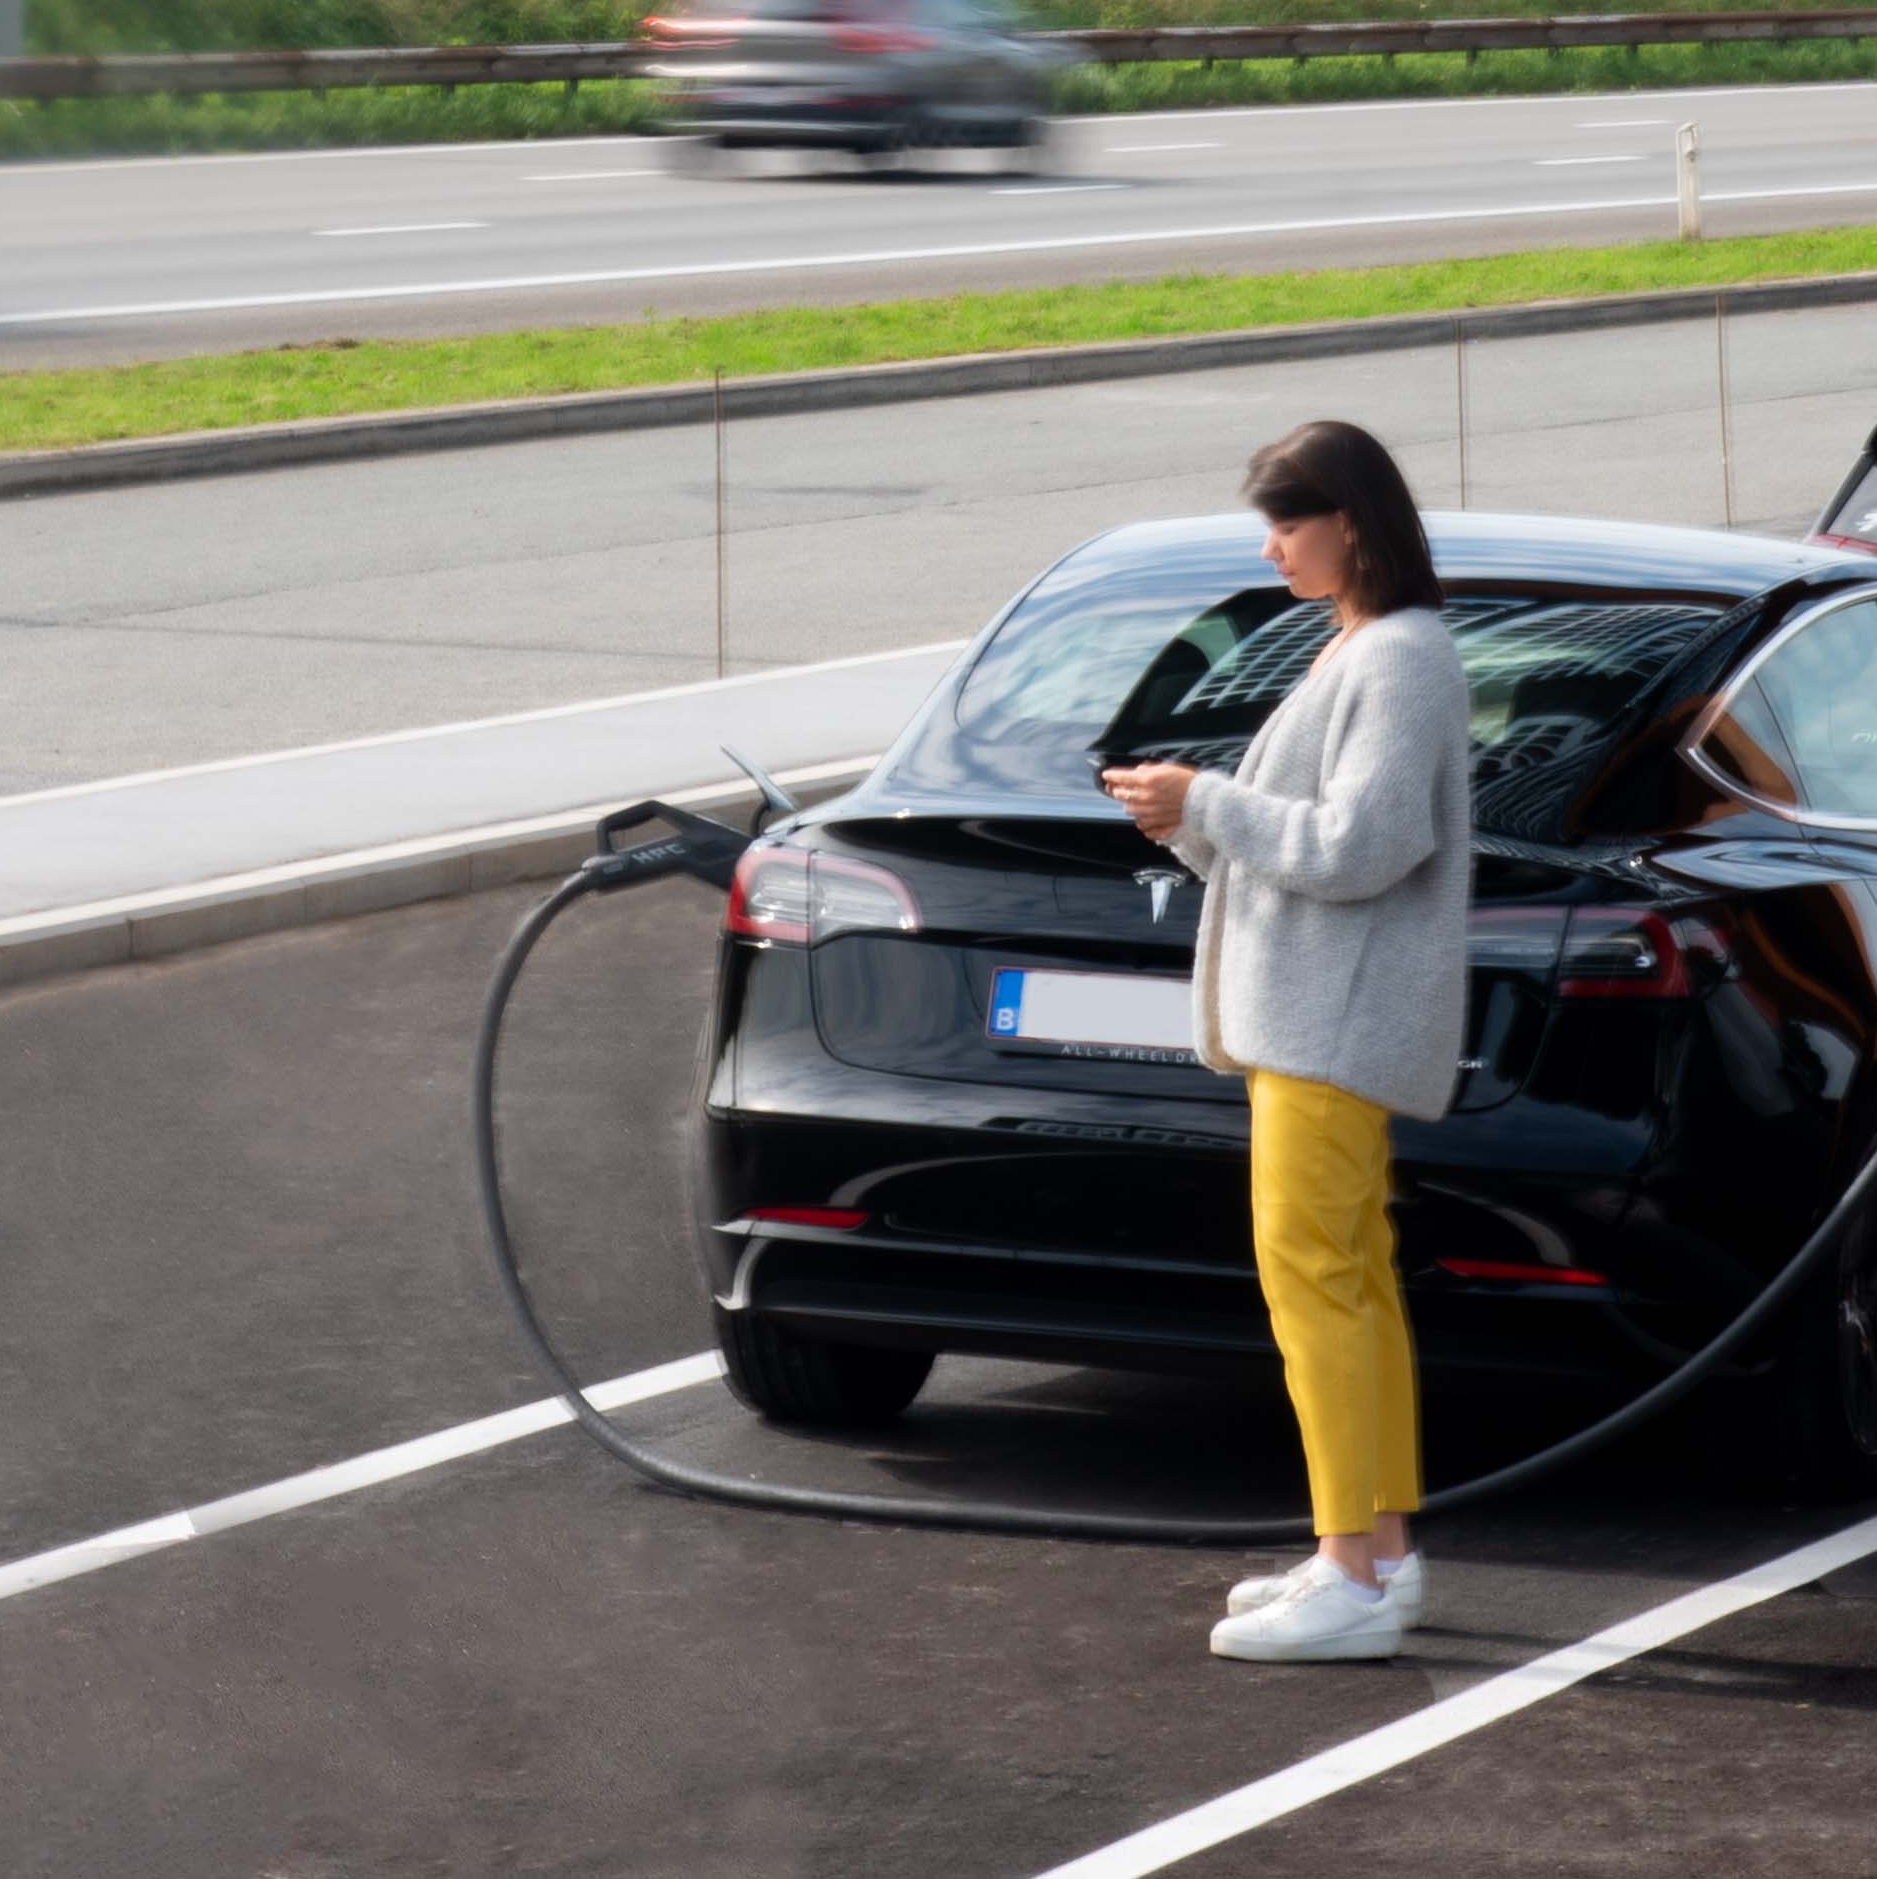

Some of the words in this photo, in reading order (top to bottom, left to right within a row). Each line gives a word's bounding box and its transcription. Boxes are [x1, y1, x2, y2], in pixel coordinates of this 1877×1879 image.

[631, 842, 686, 865] HPC
[996, 1007, 1015, 1031] B
[1060, 1044, 1169, 1062] ALL-WHEEL
